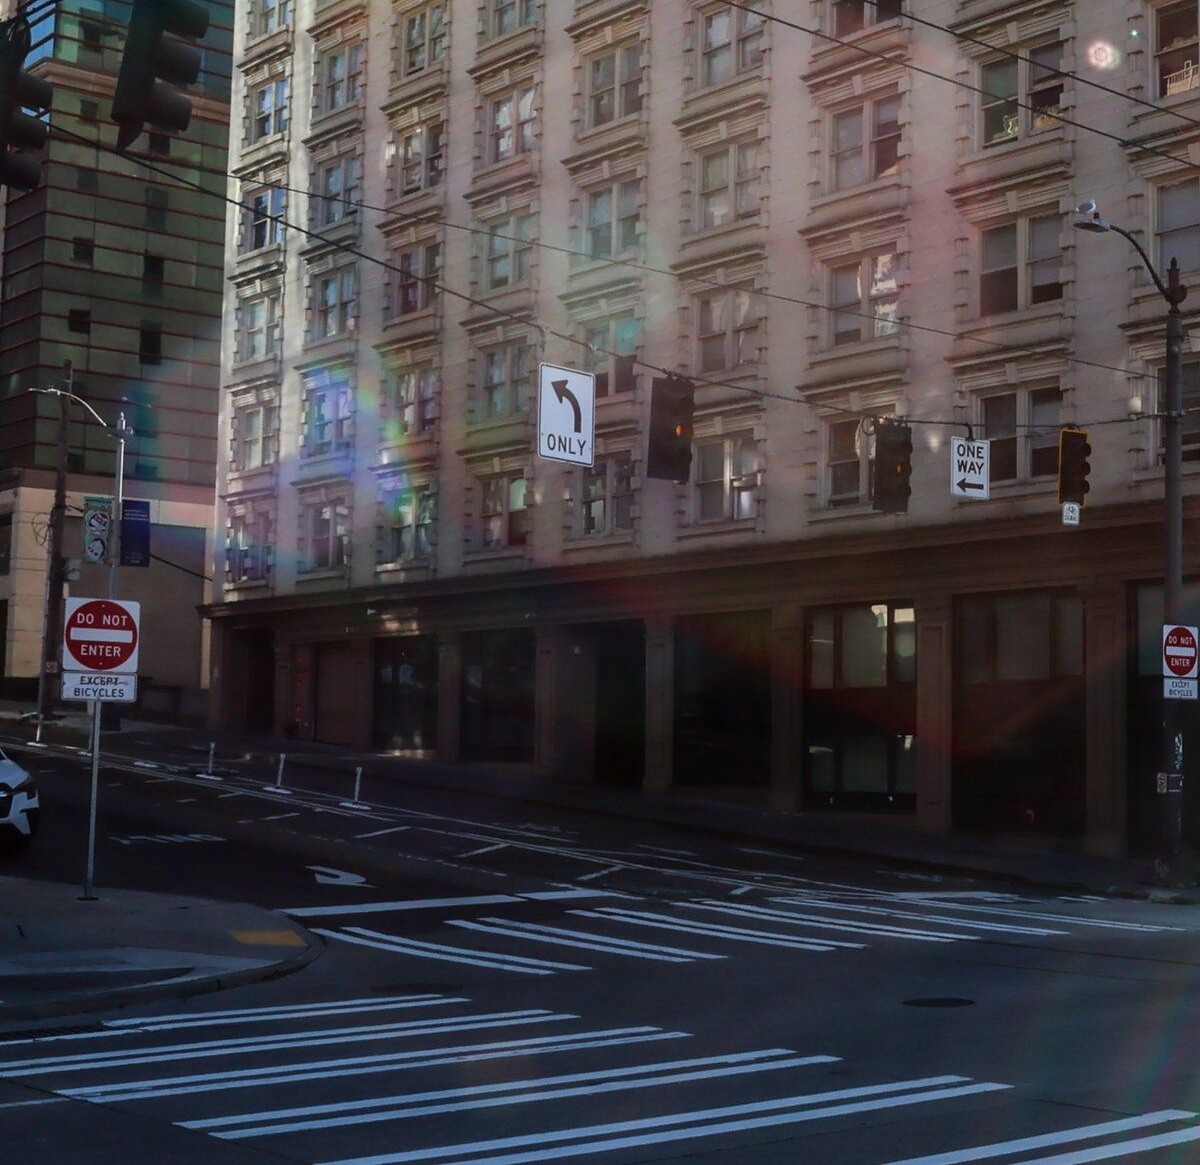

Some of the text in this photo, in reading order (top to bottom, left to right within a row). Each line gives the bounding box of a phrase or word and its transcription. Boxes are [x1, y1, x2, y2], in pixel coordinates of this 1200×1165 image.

[547, 433, 587, 456] ONLY
[957, 443, 984, 459] ONE
[957, 459, 984, 475] WAY
[77, 613, 128, 626] DO NOT
[1168, 635, 1193, 645] DO NOT
[80, 644, 121, 657] ENTER
[1170, 657, 1191, 667] ENTER
[80, 676, 120, 686] EXCEPT
[1171, 680, 1191, 690] EXCEPT
[73, 687, 125, 698] BICYCLES
[1168, 689, 1193, 698] BICYCLES
